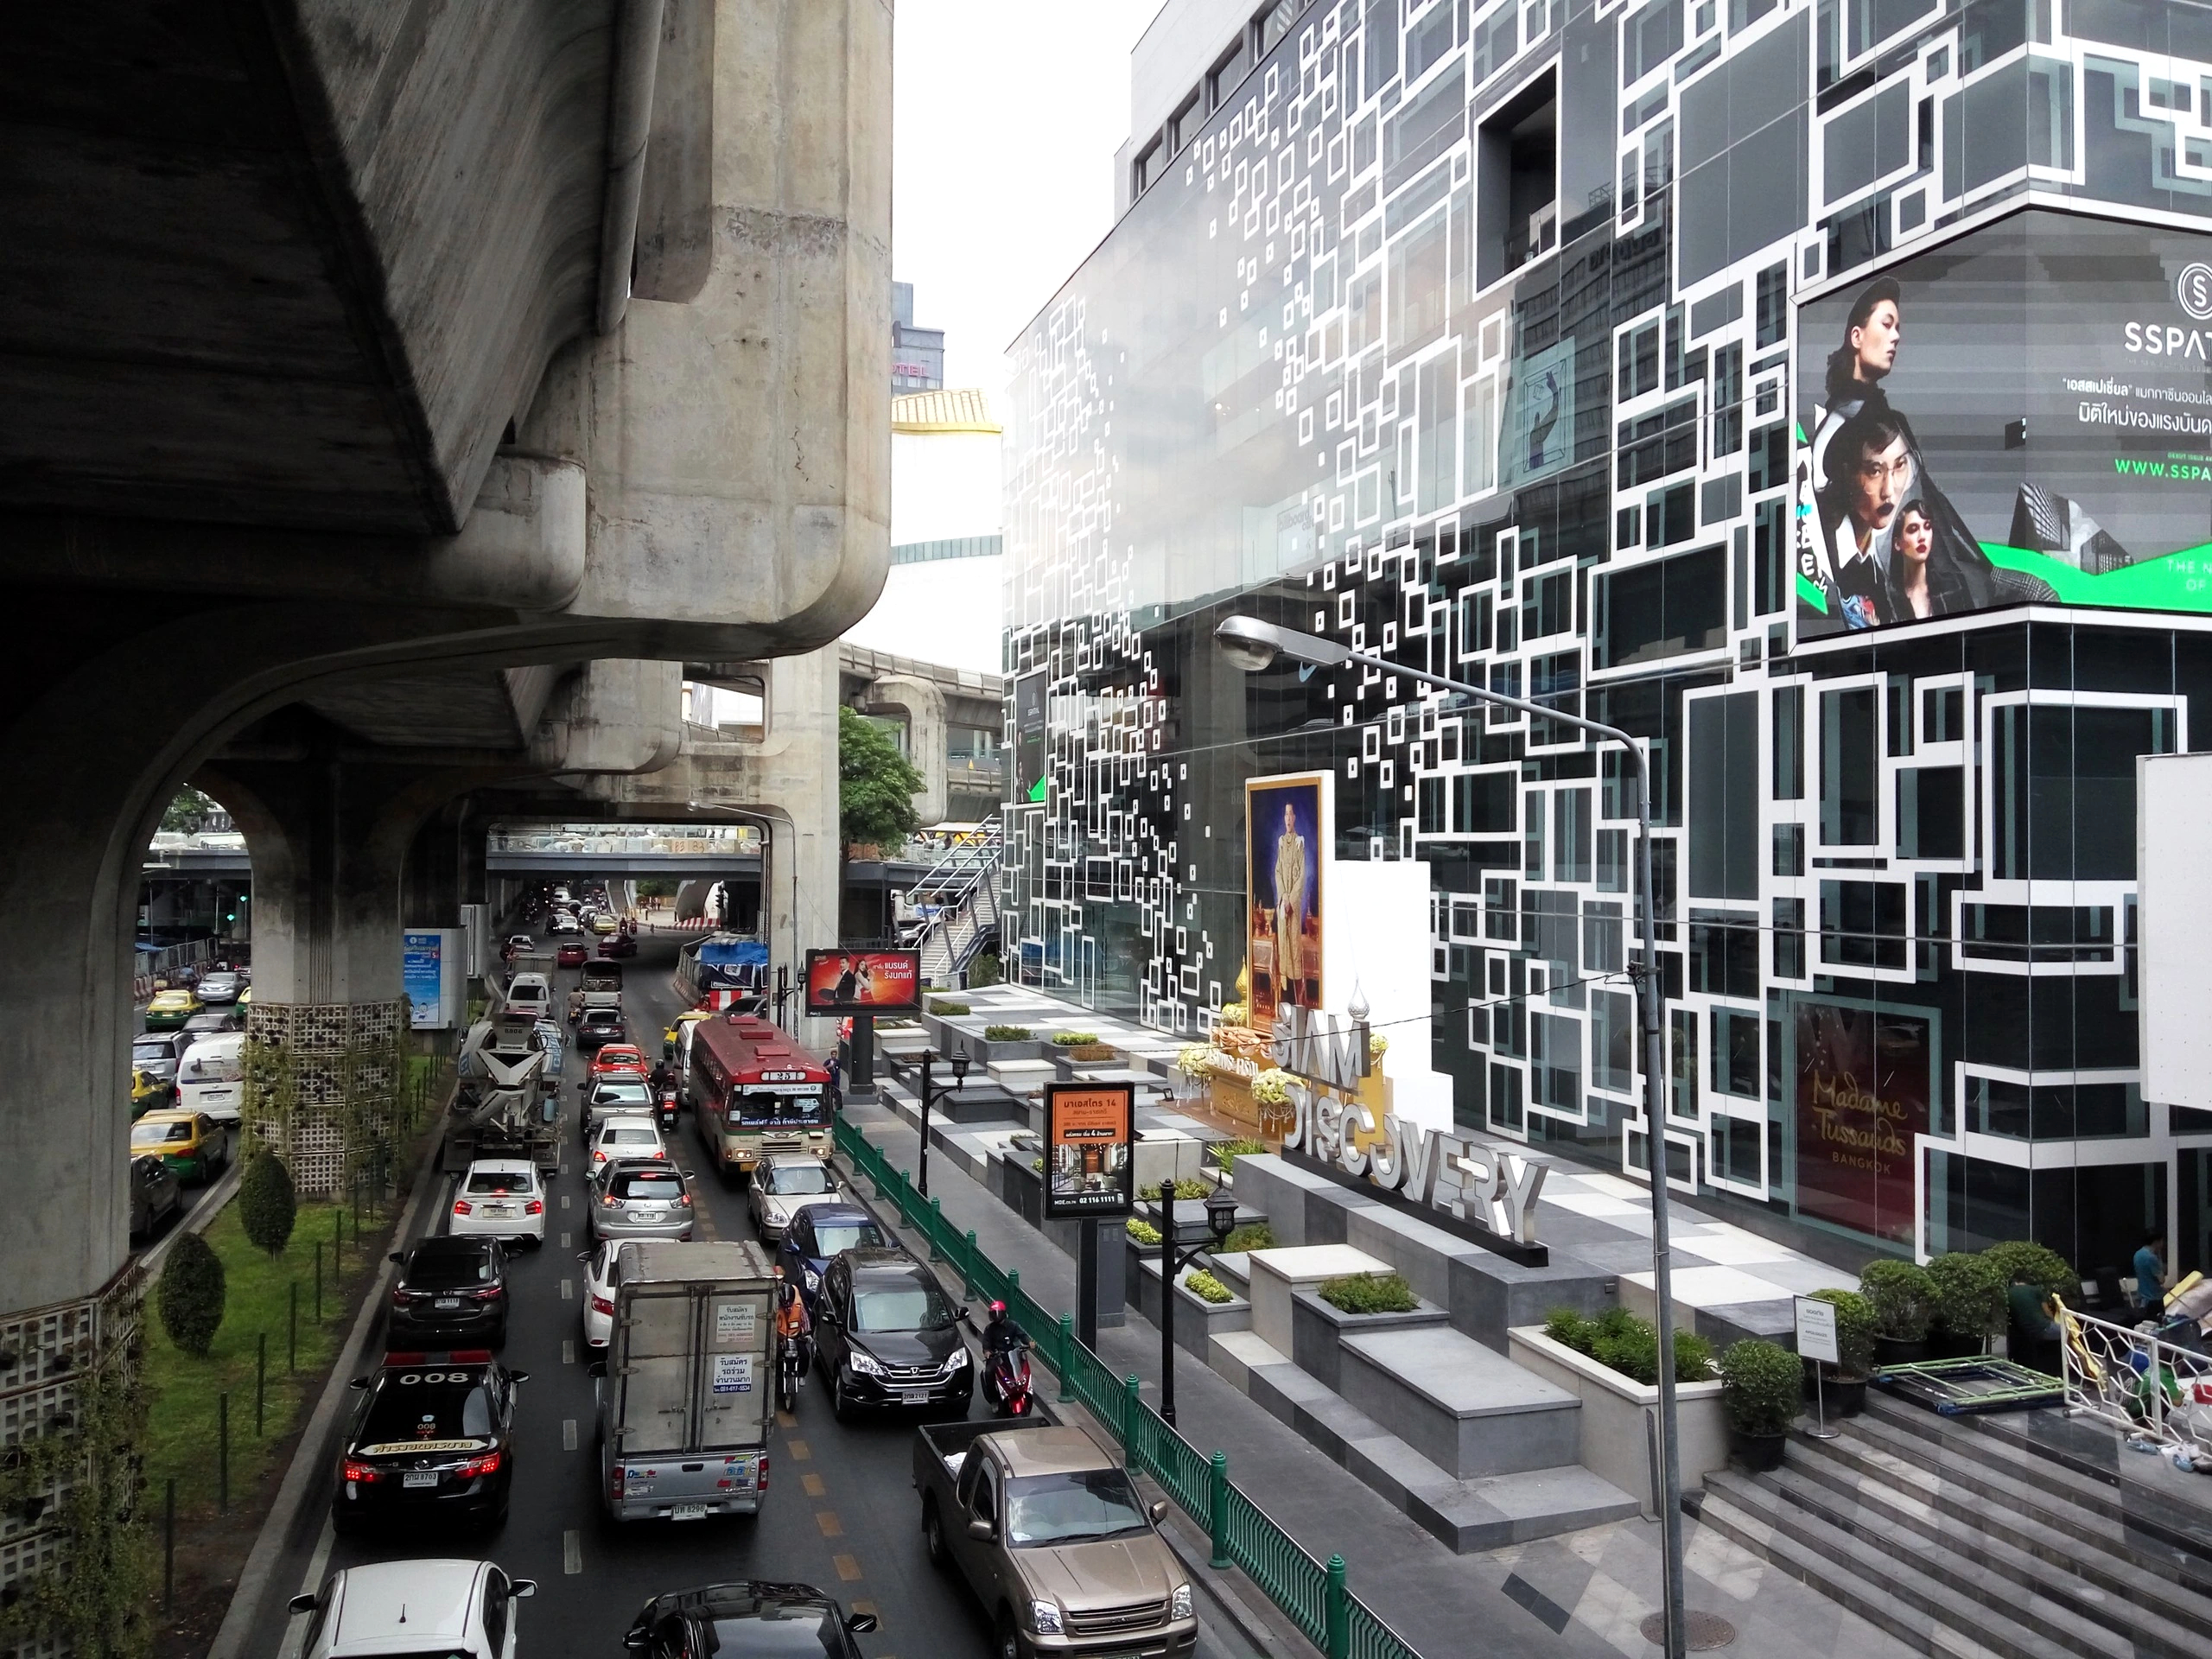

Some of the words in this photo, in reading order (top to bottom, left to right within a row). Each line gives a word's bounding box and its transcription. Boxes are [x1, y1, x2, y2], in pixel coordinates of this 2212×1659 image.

[1272, 1002, 1370, 1090] SIAM
[1812, 1069, 1908, 1121] Madame
[1812, 1106, 1906, 1156] Tussauds
[1285, 1083, 1549, 1244] DISCOVERY
[1832, 1151, 1891, 1175] BANGKOK
[399, 1372, 469, 1385] 008
[720, 1357, 747, 1366] รับสมัคร
